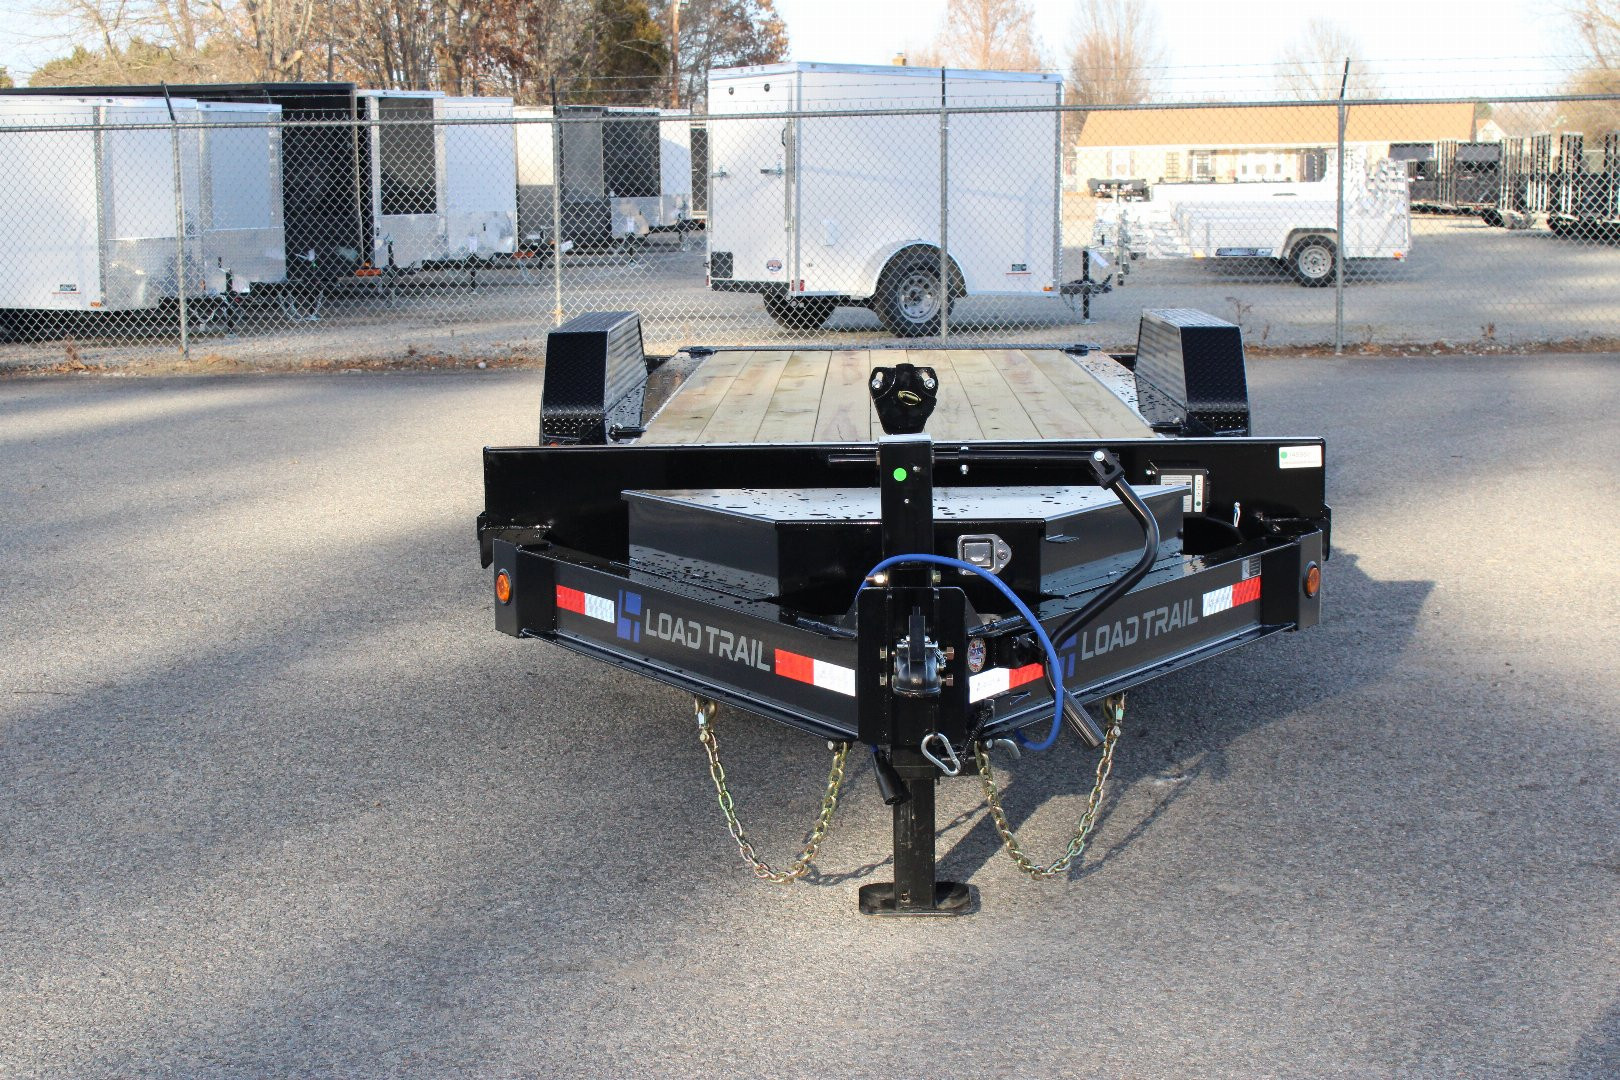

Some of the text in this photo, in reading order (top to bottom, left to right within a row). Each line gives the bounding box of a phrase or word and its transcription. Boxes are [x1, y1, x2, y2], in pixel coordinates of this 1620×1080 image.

[646, 608, 771, 672] LOAD TRAIL
[1082, 598, 1199, 661] LOAD TRAIL
